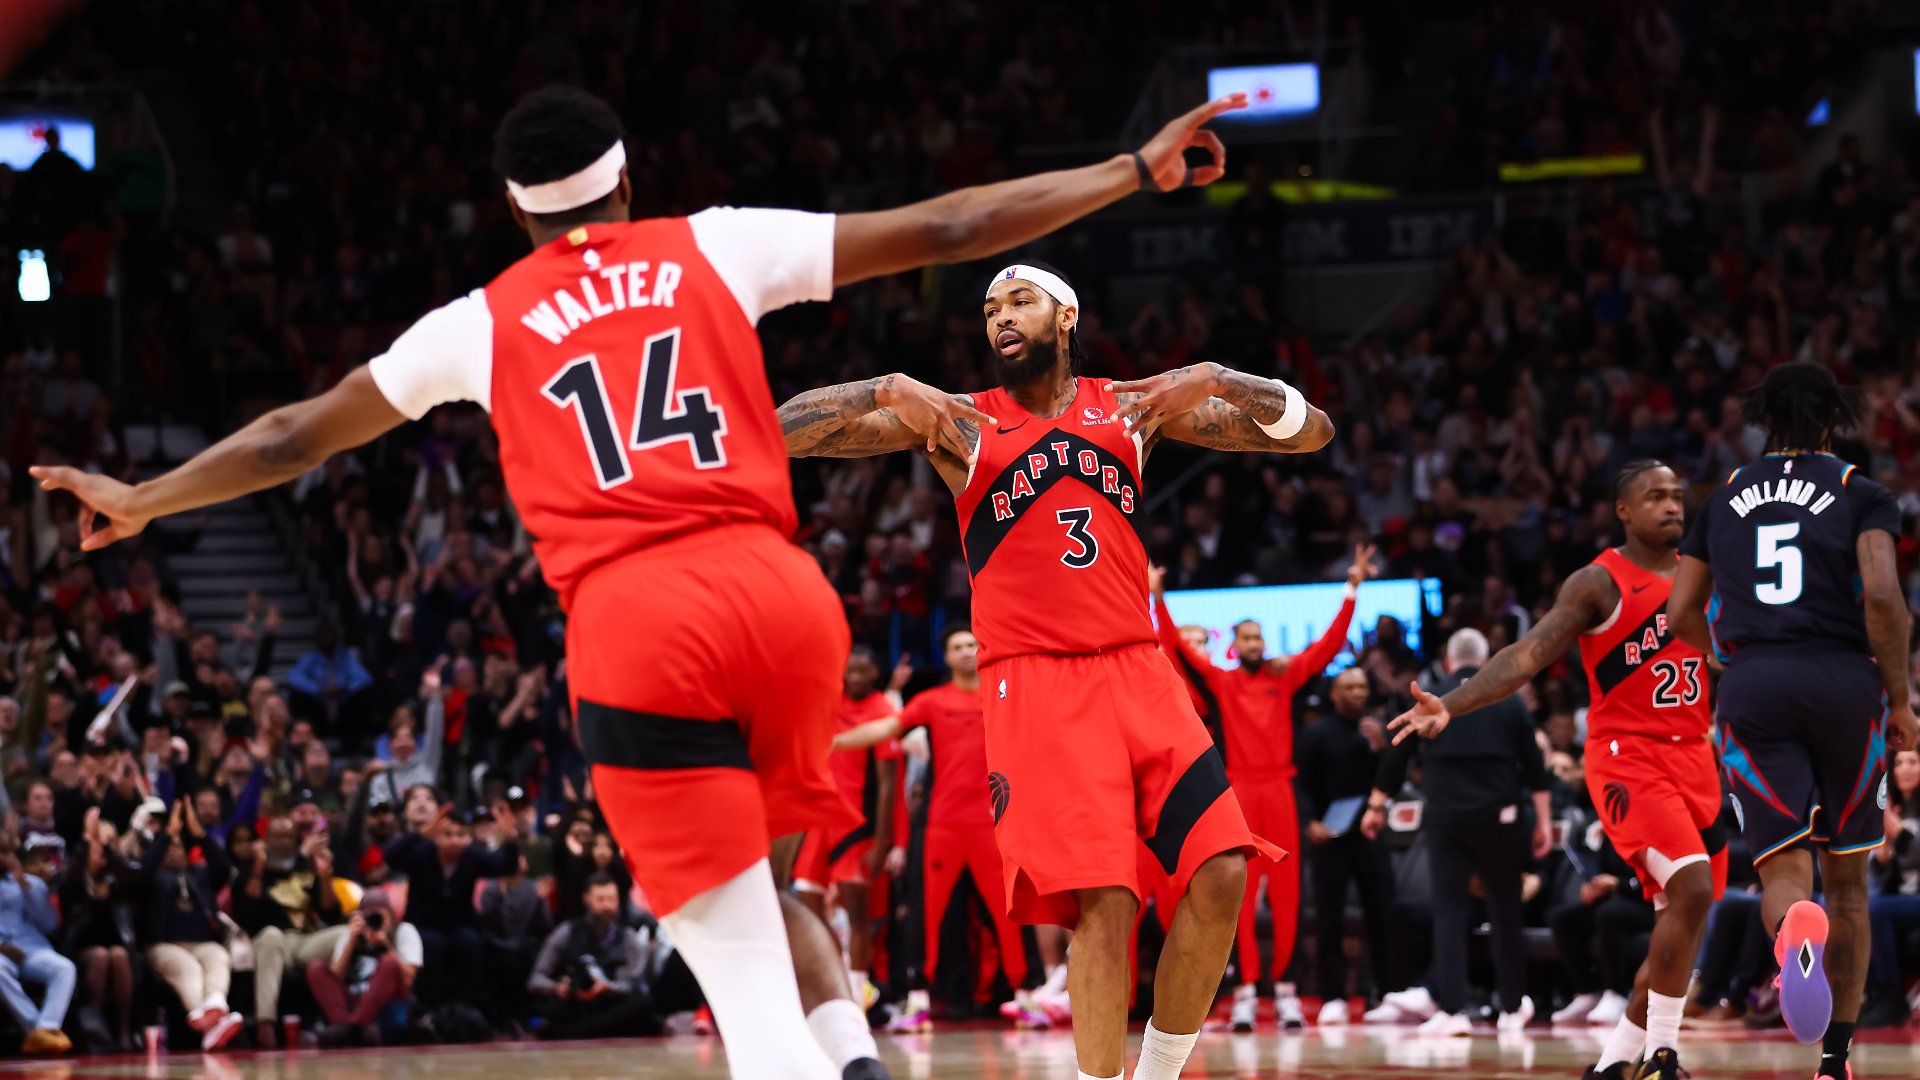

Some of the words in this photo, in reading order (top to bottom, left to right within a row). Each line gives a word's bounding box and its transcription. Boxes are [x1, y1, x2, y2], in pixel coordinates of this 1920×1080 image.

[520, 261, 683, 345] WALTER
[540, 326, 728, 491] 14
[992, 441, 1134, 522] RAPTORS
[1729, 479, 1817, 518] HOLLAND
[1808, 491, 1836, 516] II
[1056, 507, 1099, 569] 3
[1755, 521, 1803, 606] 5
[1625, 613, 1669, 665] RAP
[1651, 657, 1702, 708] 23
